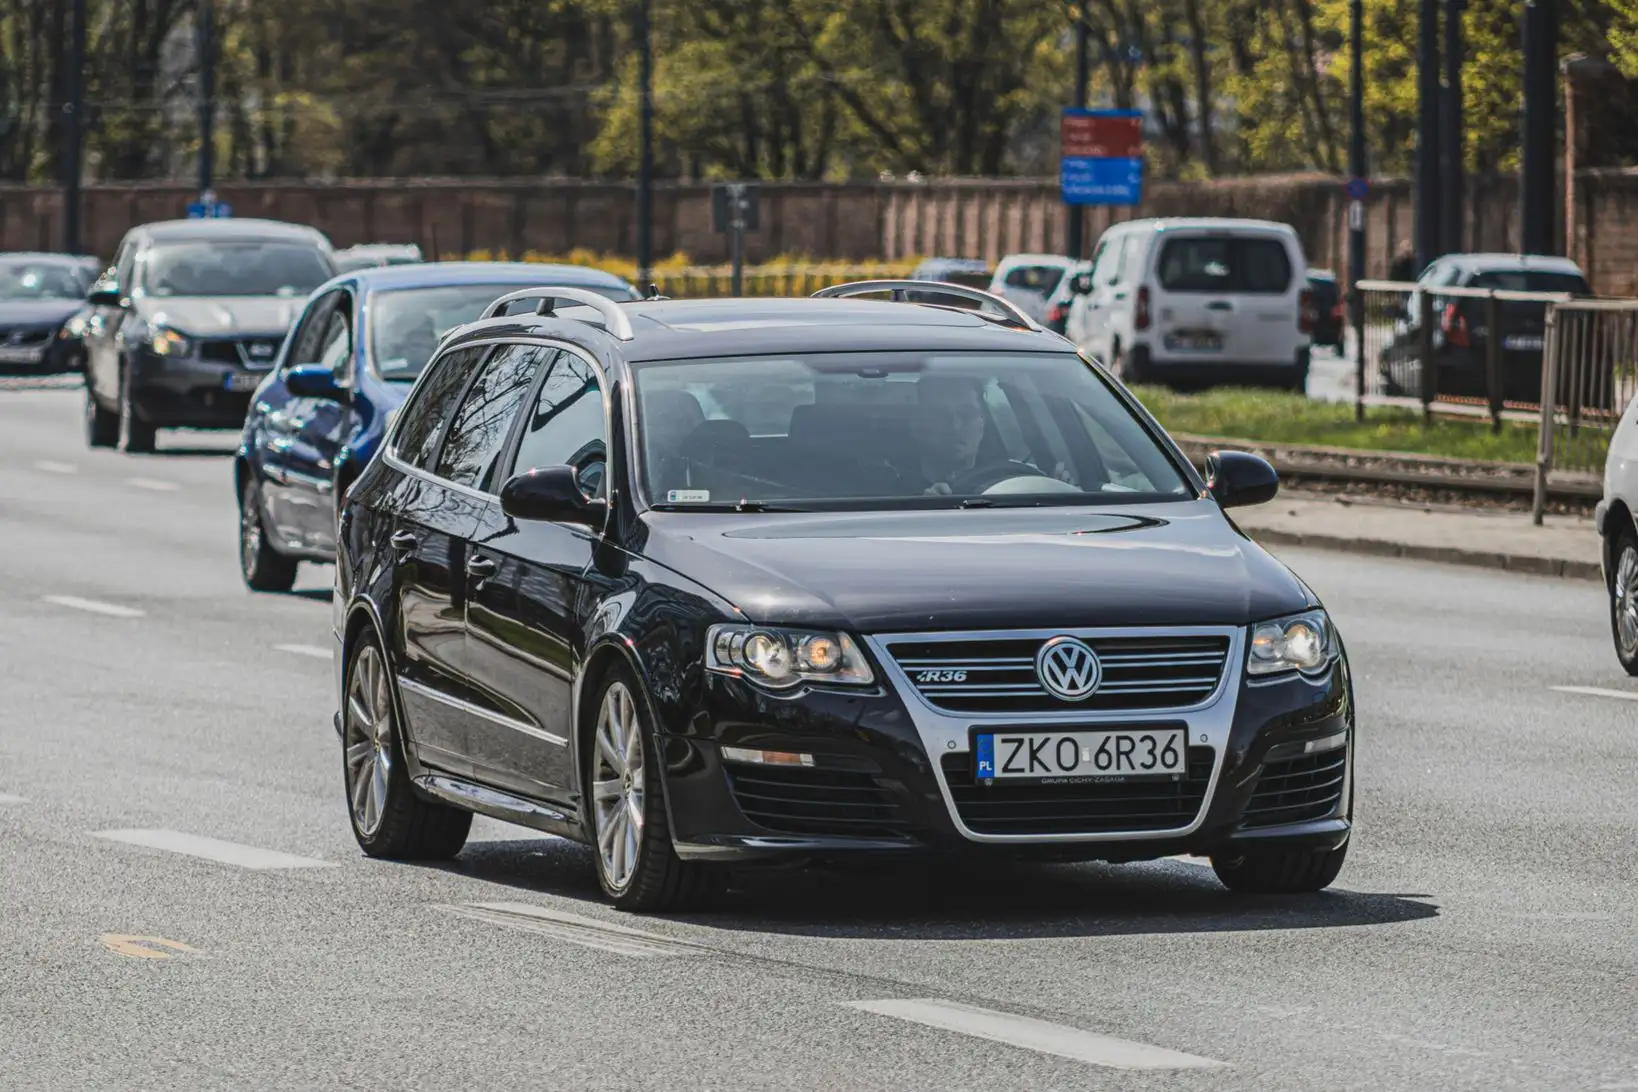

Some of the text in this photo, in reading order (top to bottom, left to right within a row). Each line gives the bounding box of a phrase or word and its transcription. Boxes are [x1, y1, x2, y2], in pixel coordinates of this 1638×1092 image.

[924, 670, 967, 682] R36
[1043, 641, 1097, 696] VW
[979, 760, 992, 771] PL
[1001, 733, 1179, 774] ZKO 6R36
